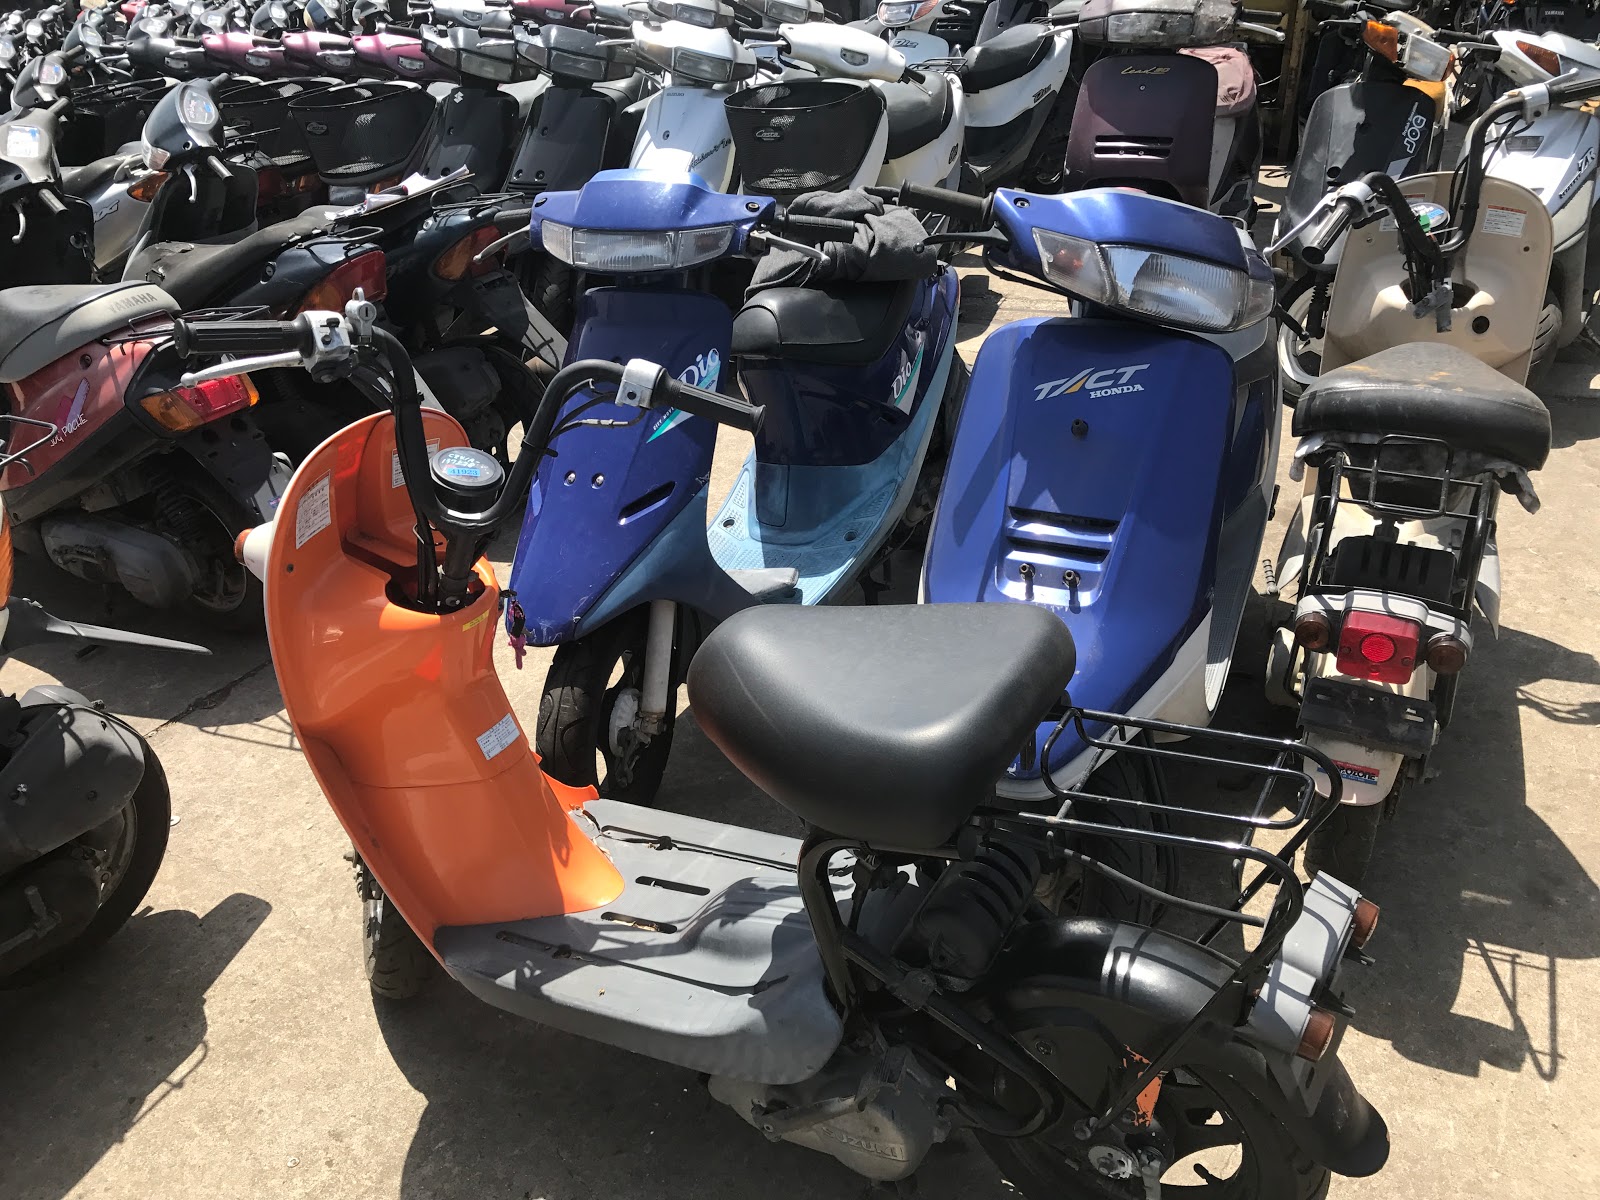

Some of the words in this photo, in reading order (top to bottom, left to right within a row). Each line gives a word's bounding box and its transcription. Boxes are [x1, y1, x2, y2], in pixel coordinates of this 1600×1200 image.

[1403, 115, 1427, 154] JOG
[109, 292, 158, 314] YAMAHA
[677, 348, 720, 386] Dio
[891, 361, 912, 399] Dio
[1033, 363, 1151, 401] TACT
[1090, 384, 1144, 399] HONDA
[61, 413, 89, 437] POCHE
[450, 468, 479, 476] 41923
[821, 1126, 905, 1160] SUZUKI
